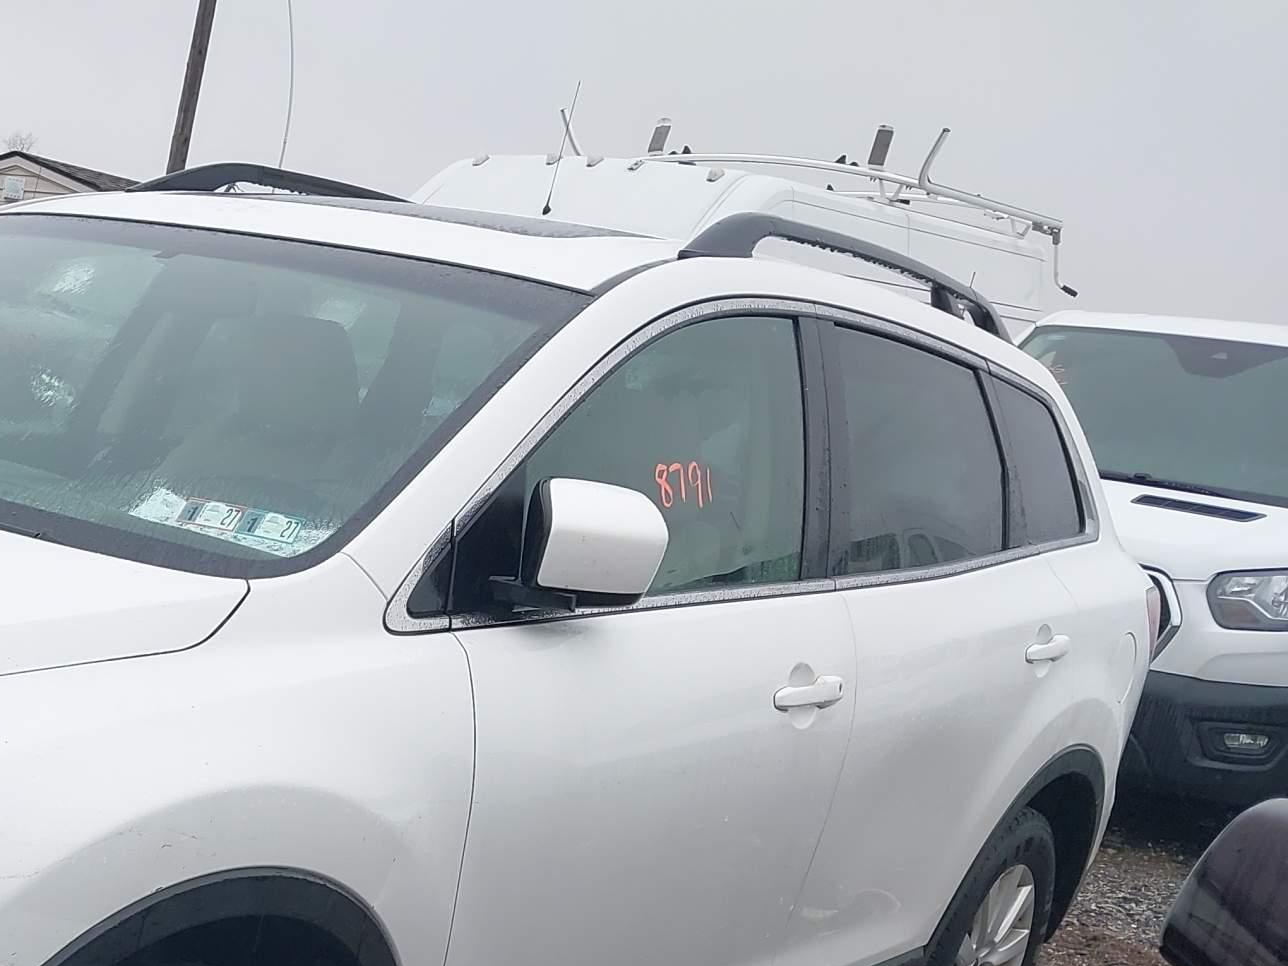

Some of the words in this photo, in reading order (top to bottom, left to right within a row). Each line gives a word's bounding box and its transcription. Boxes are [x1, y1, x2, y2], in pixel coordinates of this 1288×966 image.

[654, 460, 713, 509] 8791
[219, 508, 241, 528] 27
[279, 520, 300, 539] 27
